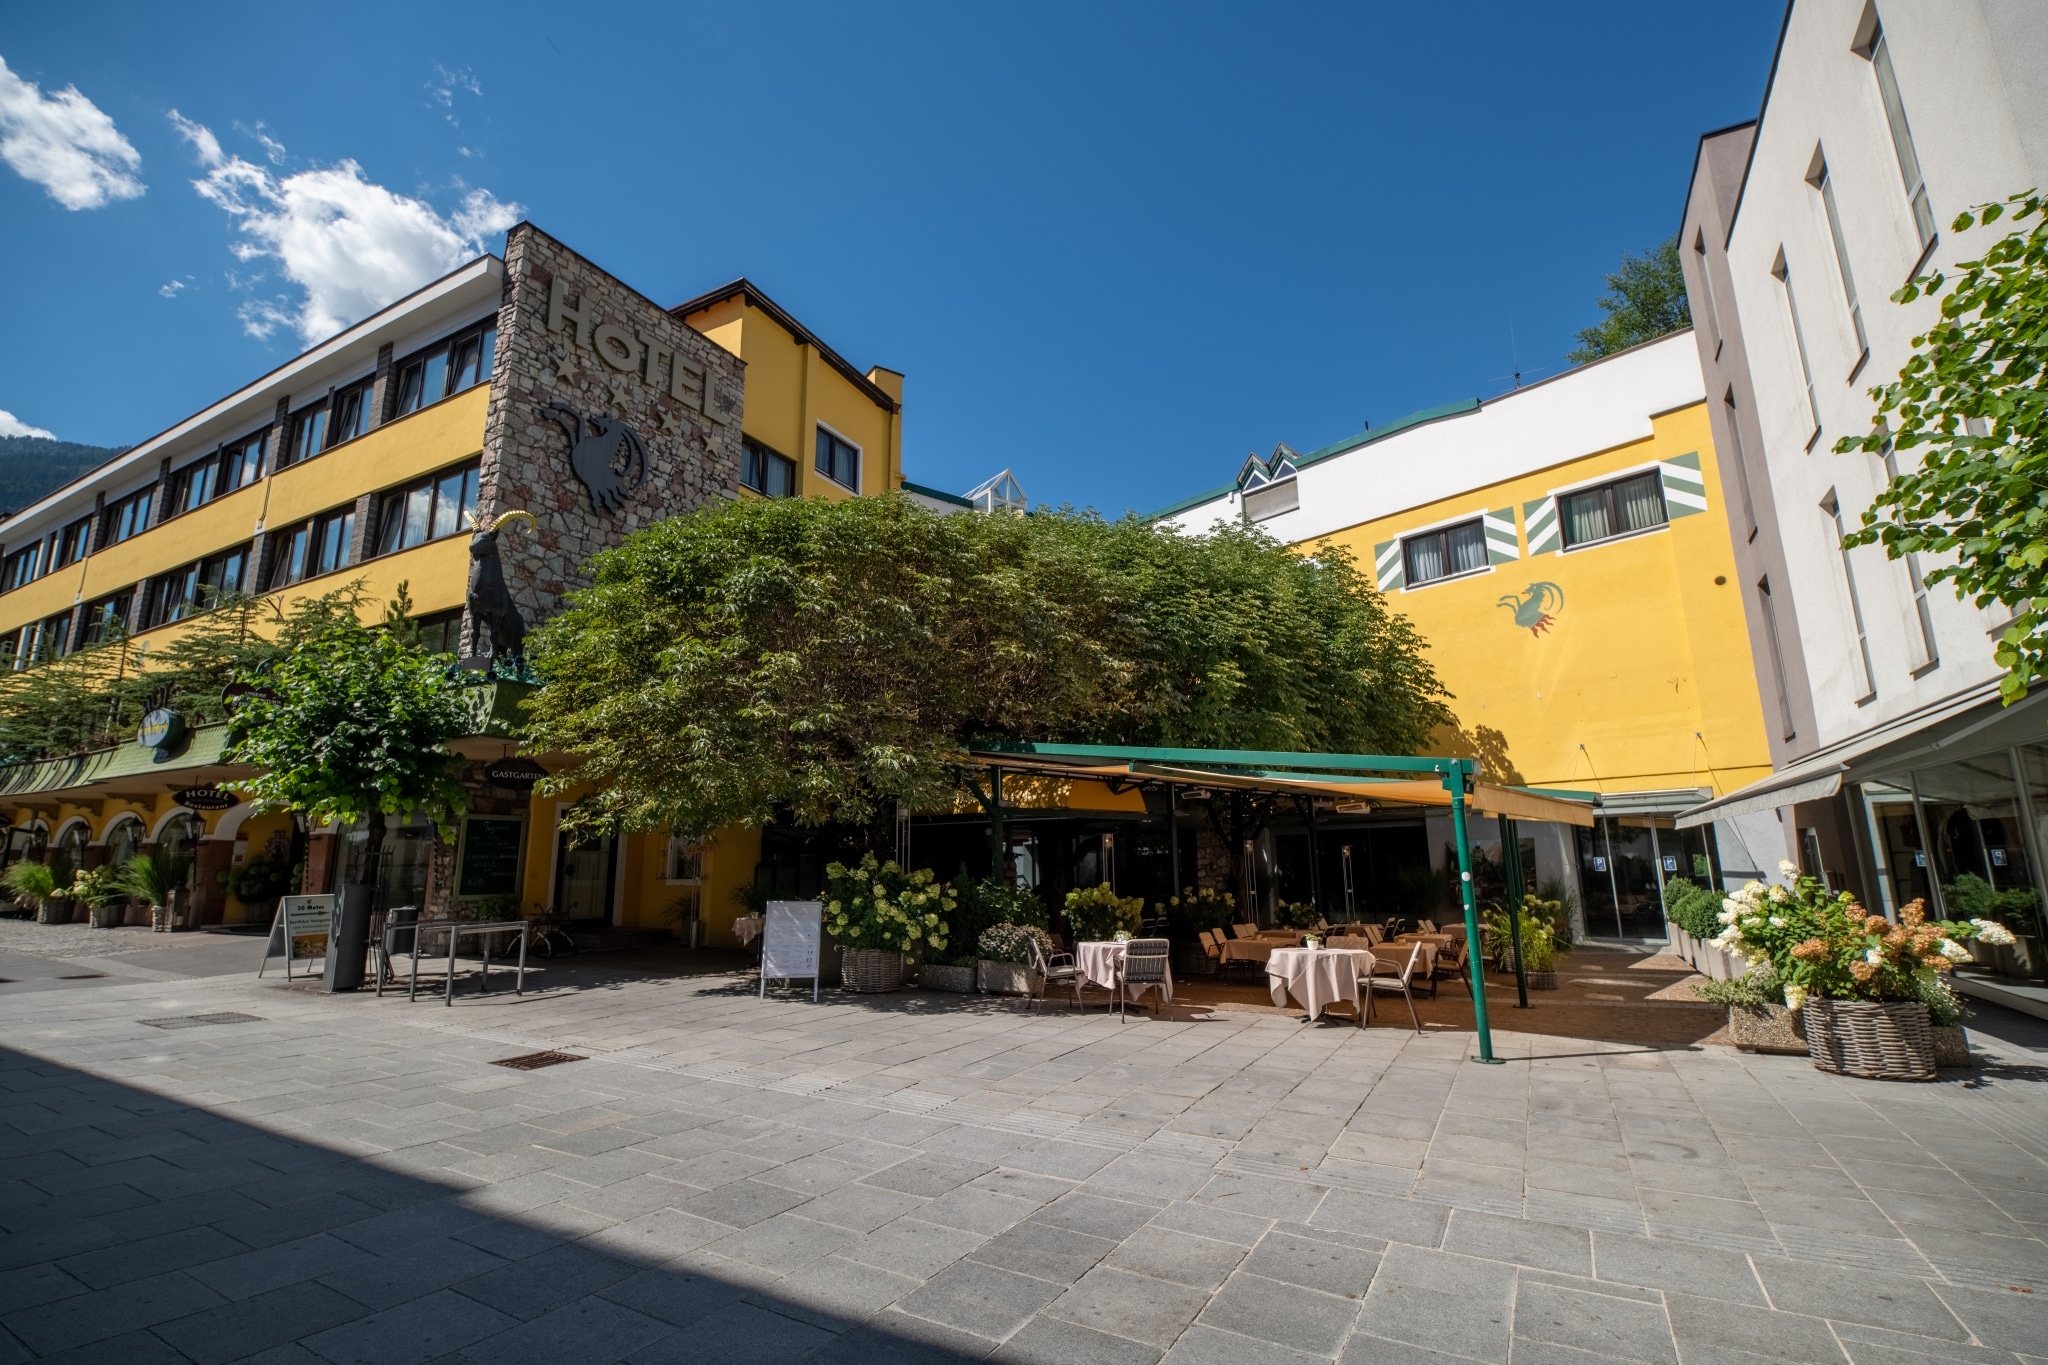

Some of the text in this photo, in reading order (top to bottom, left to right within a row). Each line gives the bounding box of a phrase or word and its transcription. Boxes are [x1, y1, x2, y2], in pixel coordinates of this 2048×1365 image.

[546, 277, 731, 427] HOTEL
[492, 771, 545, 780] GASTGARTEN
[185, 789, 229, 801] HOTEL
[184, 800, 228, 809] Restaurant
